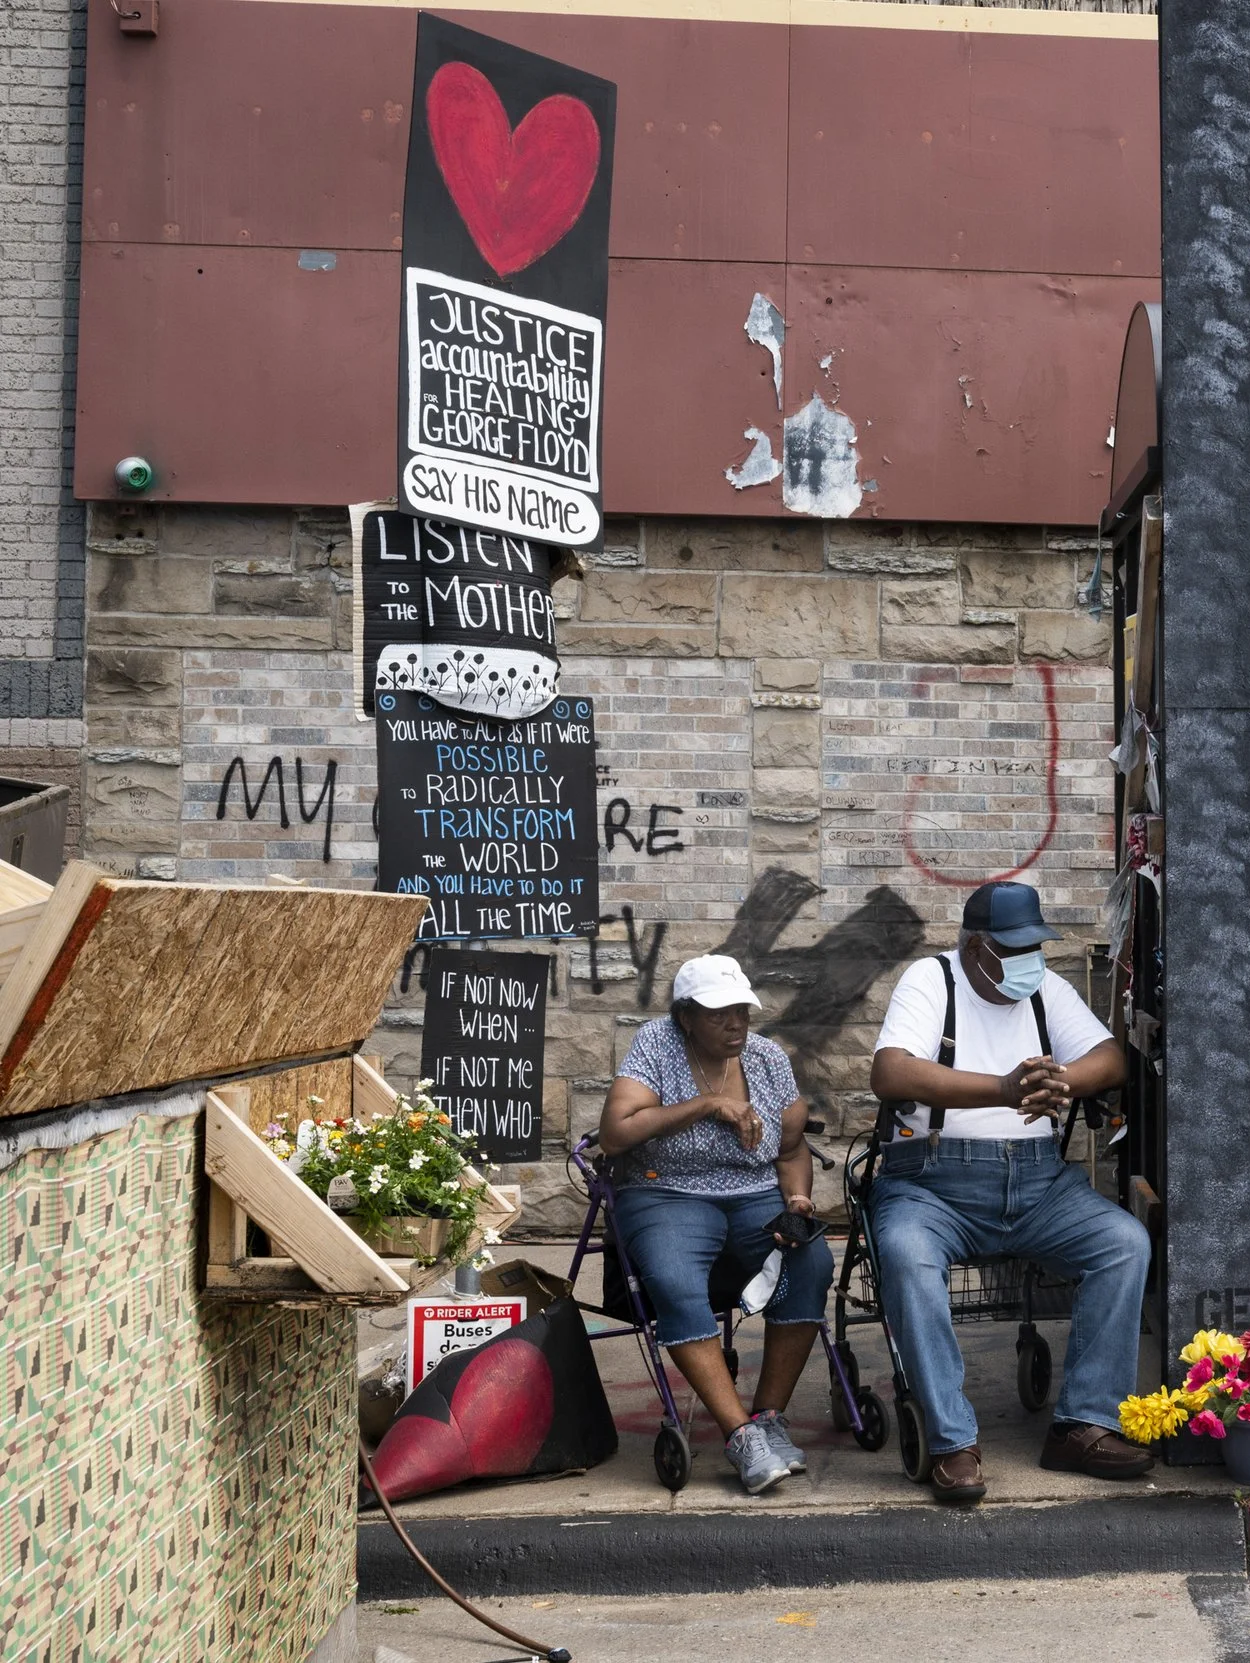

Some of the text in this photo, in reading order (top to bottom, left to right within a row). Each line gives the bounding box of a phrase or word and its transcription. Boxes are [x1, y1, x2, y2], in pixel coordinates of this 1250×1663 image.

[429, 292, 588, 373] JUSTICE
[421, 340, 590, 418] accountability
[424, 374, 577, 436] FOR HEALING
[423, 404, 591, 476] GEORGE FLOYD
[464, 474, 501, 513] HIS
[387, 582, 410, 595] TO
[386, 719, 420, 742] YOU
[526, 722, 538, 744] IF
[541, 722, 552, 744] IT
[401, 788, 417, 800] TO
[460, 842, 560, 875] WORLD
[397, 874, 431, 894] AND
[435, 874, 465, 895] YOU
[518, 879, 535, 895] TO
[541, 877, 563, 896] DO
[570, 878, 584, 896] IT
[419, 899, 471, 938] ALL
[441, 971, 539, 1011] IF NOT NOW
[436, 1057, 452, 1086] IF
[460, 1057, 500, 1088] NOT
[437, 1308, 473, 1319] RIDER
[475, 1306, 513, 1318] ALERT
[444, 1324, 493, 1338] Buses
